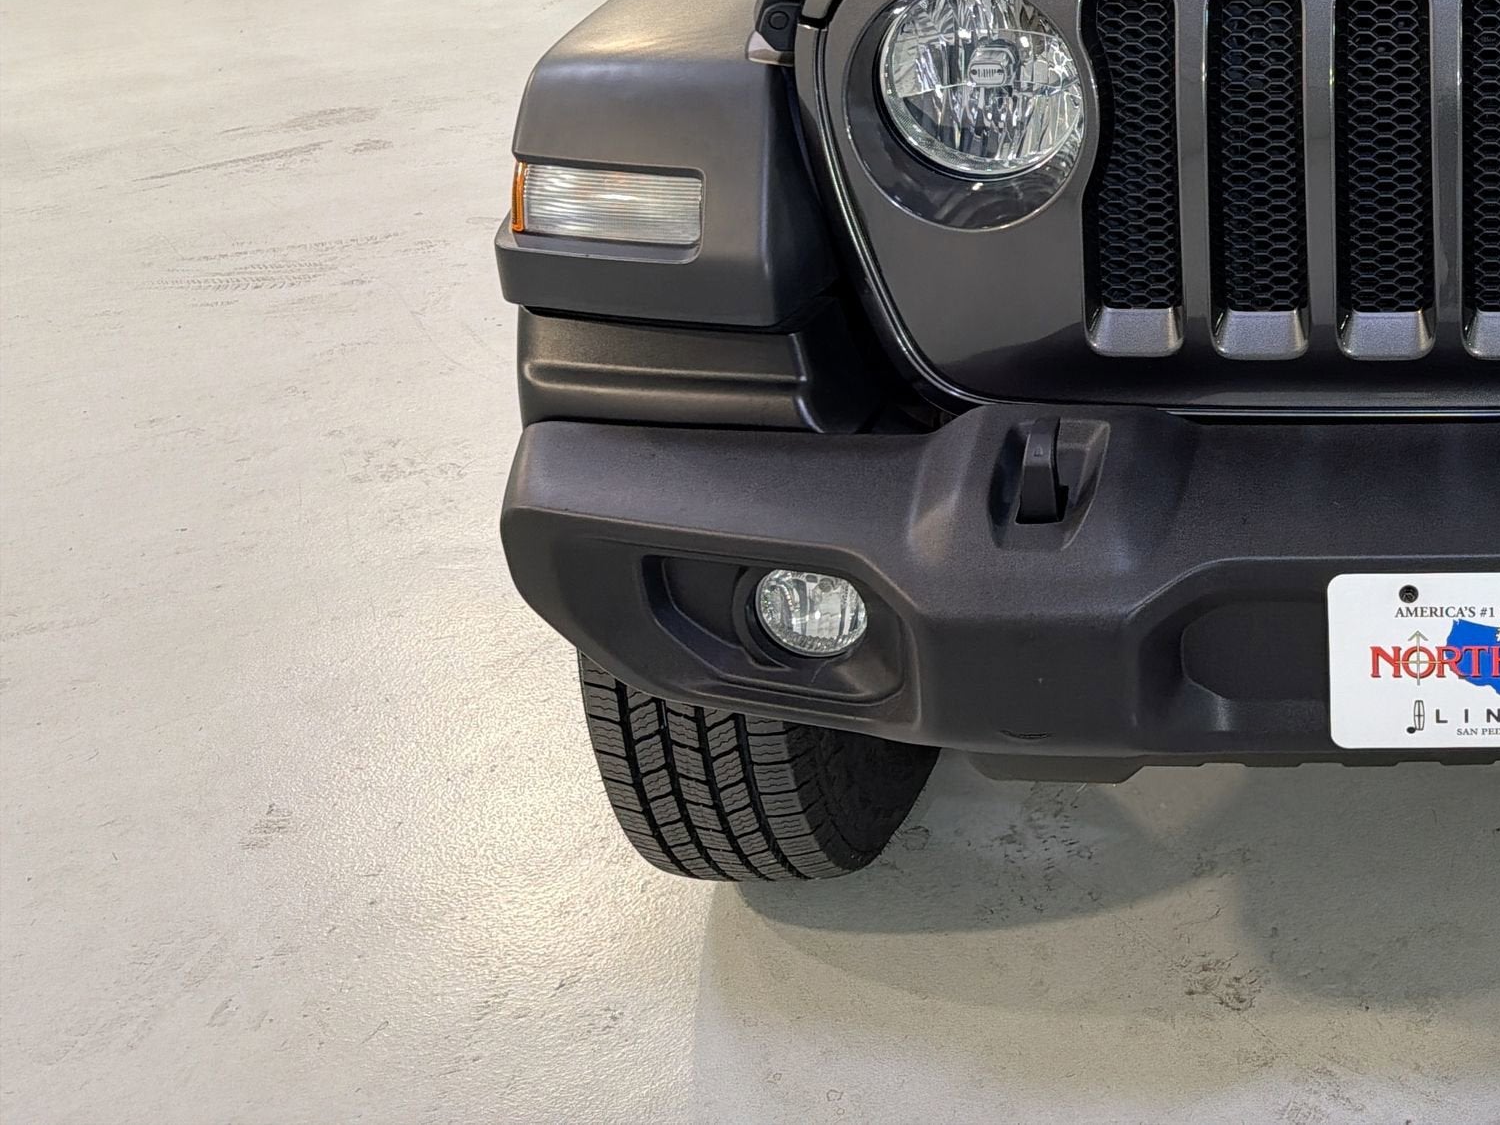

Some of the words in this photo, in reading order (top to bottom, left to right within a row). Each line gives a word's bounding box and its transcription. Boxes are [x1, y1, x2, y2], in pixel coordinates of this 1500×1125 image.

[1395, 606, 1477, 618] AMERICA'S
[1480, 606, 1495, 618] #1
[1456, 727, 1478, 736] SAN
